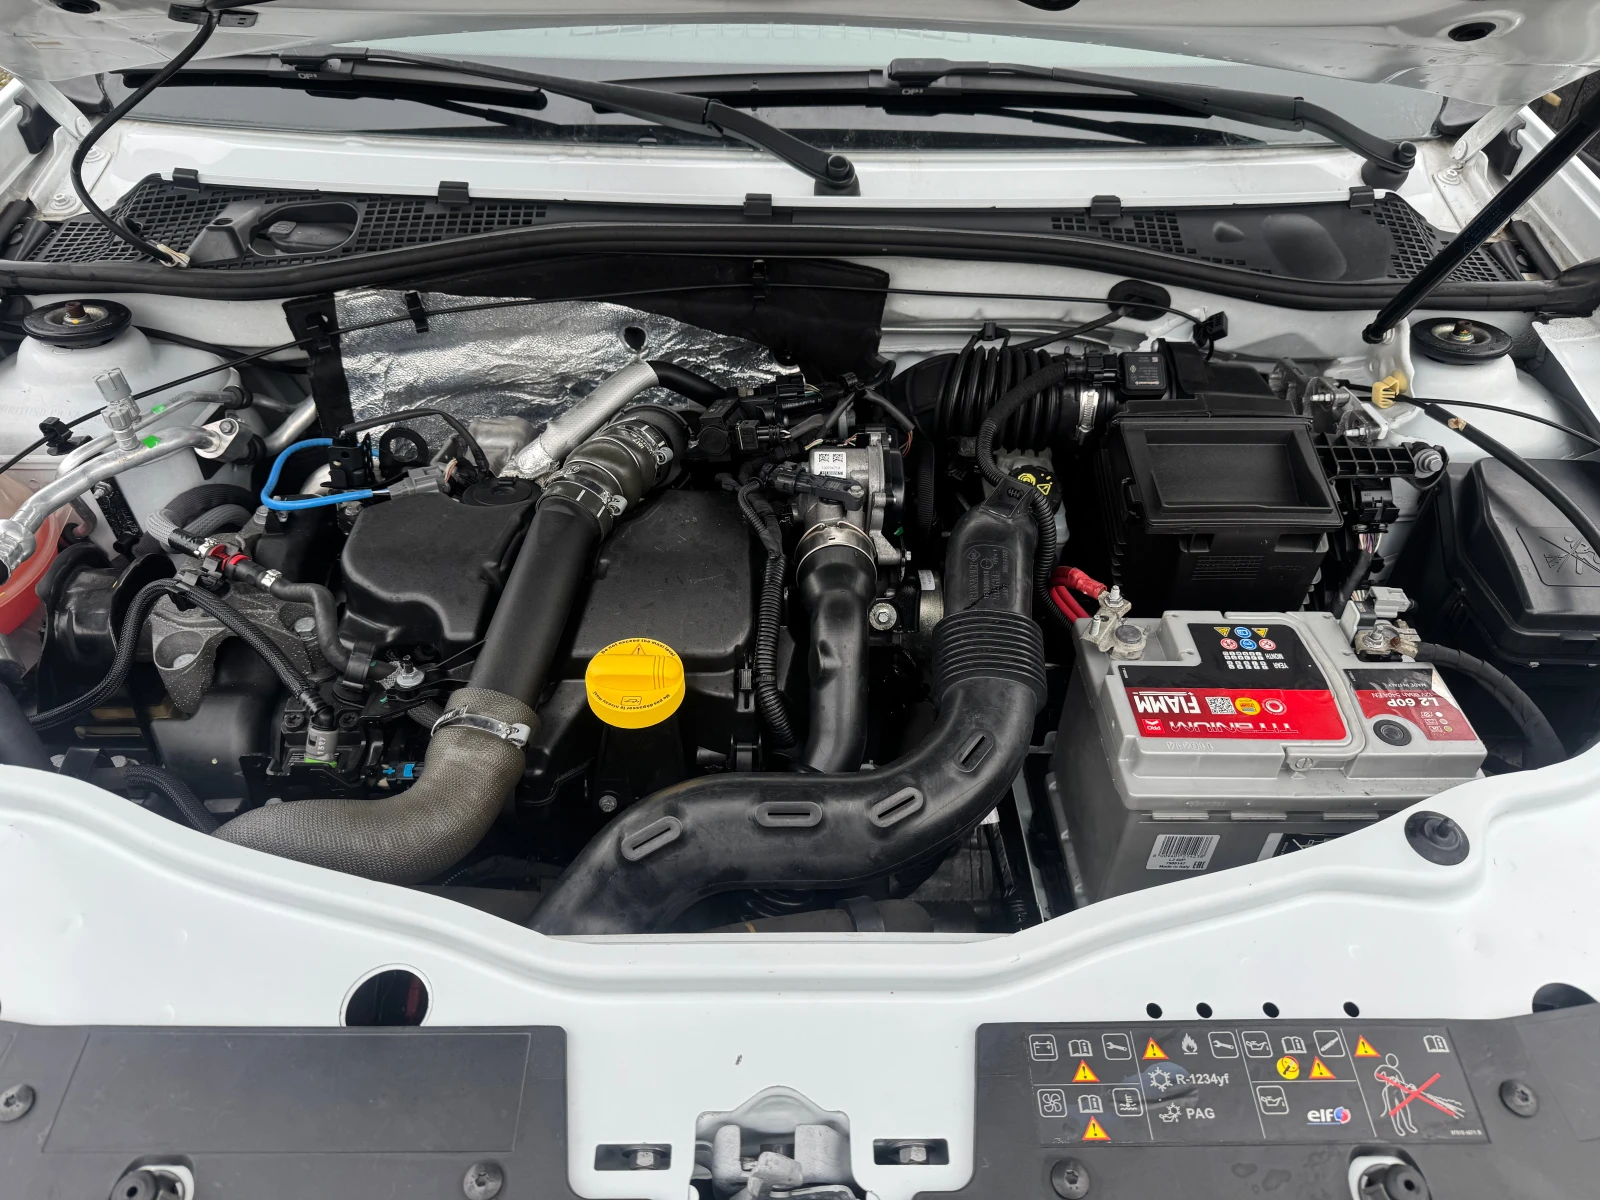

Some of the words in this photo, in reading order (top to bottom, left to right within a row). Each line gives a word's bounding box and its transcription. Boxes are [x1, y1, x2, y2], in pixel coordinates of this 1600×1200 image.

[1133, 694, 1202, 715] FIAMM
[1386, 697, 1416, 707] 60P
[1418, 697, 1440, 707] L2
[1175, 1072, 1230, 1087] R-1234yf
[1185, 1107, 1216, 1120] PAG
[1307, 1108, 1334, 1122] elf
